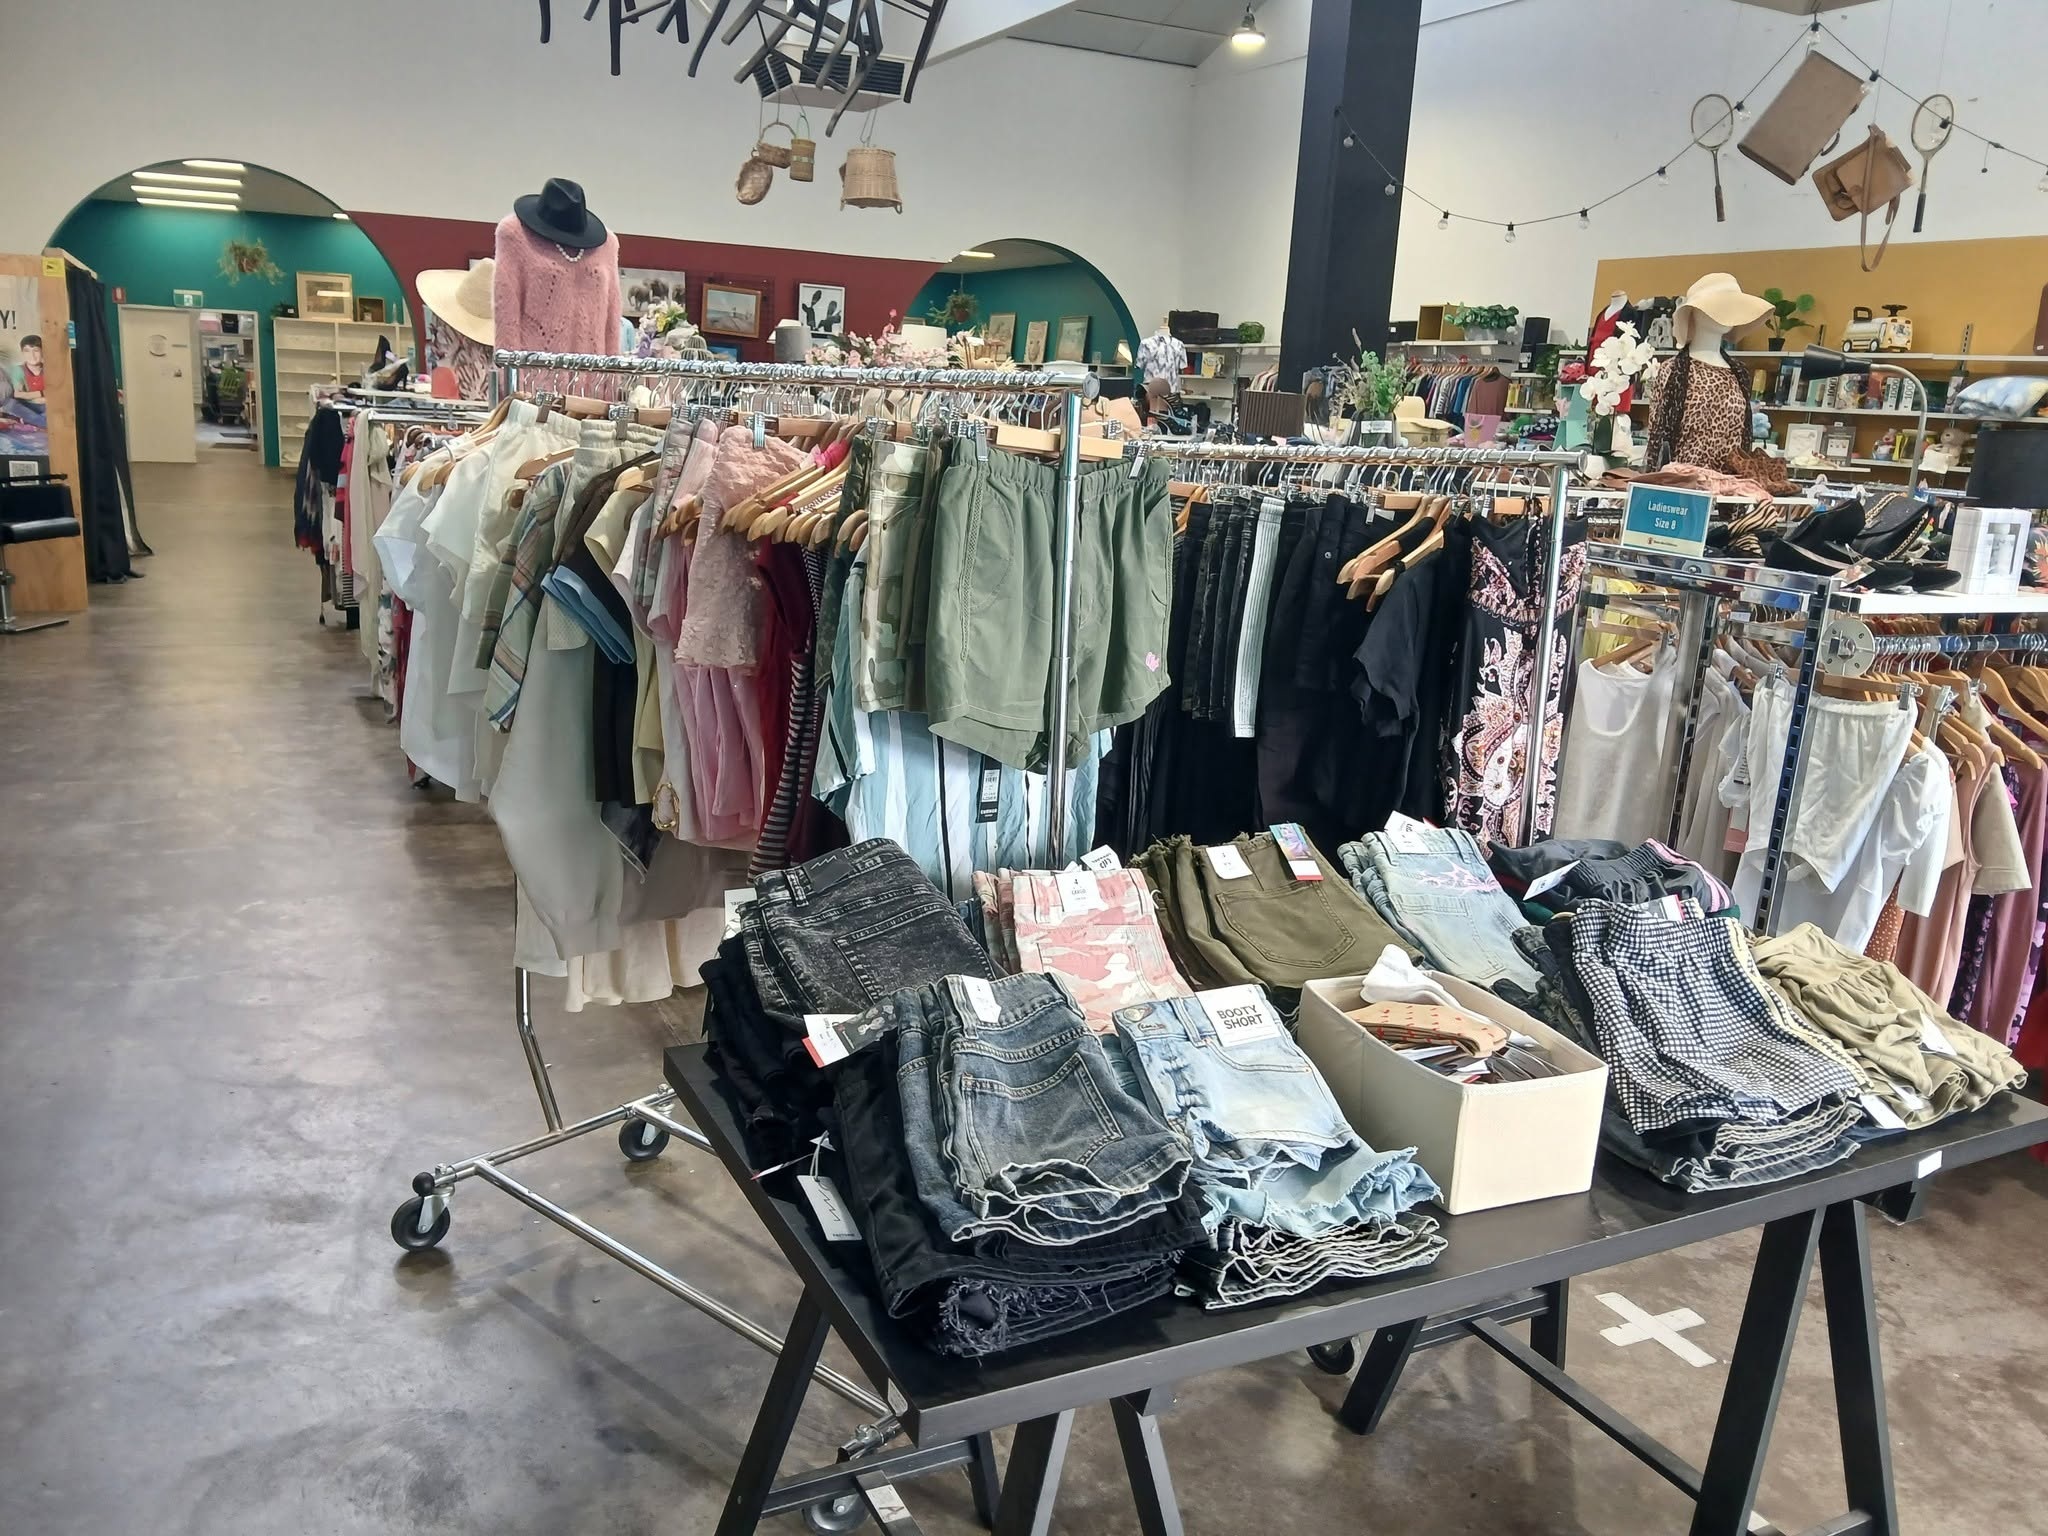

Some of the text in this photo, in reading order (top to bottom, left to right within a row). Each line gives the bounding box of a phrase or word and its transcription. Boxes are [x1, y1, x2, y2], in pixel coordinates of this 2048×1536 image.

[1891, 379, 1899, 399] 1000
[1648, 501, 1688, 516] Ladieswear
[1654, 518, 1676, 530] Size 8
[1216, 1004, 1257, 1019] BOOTY
[1223, 1013, 1263, 1030] SHORT
